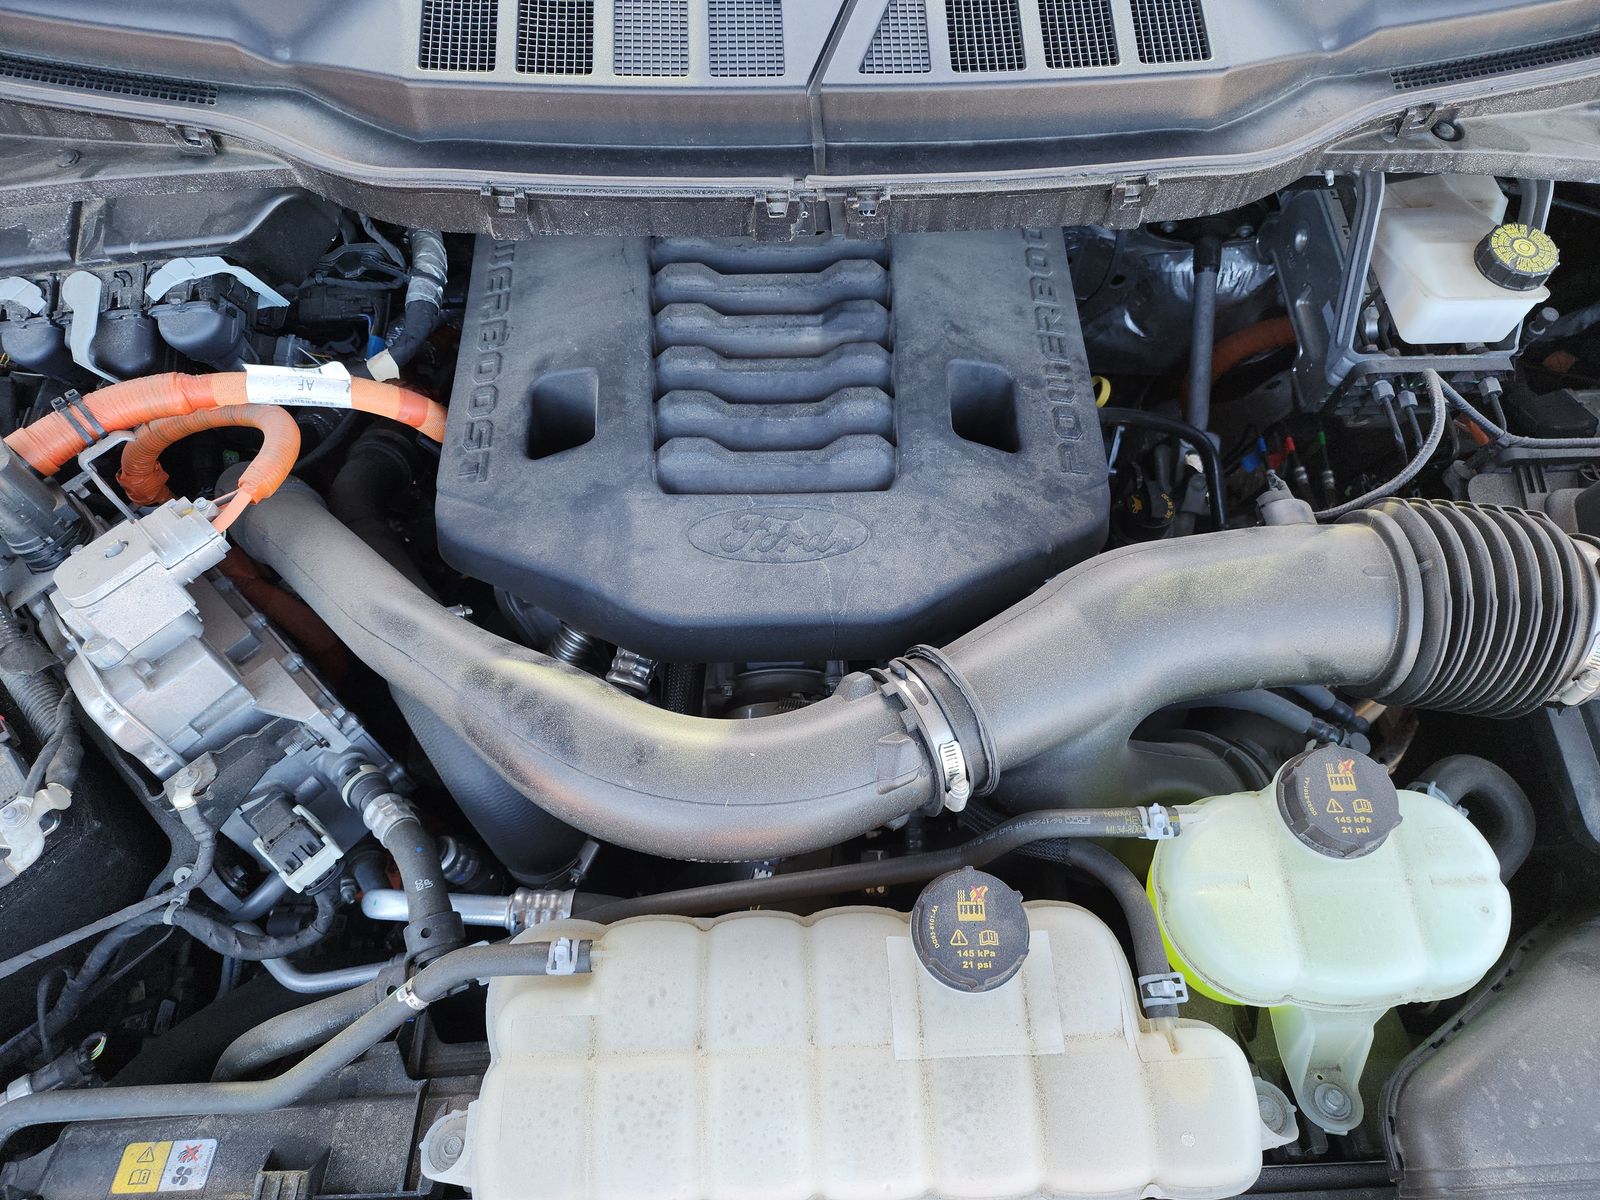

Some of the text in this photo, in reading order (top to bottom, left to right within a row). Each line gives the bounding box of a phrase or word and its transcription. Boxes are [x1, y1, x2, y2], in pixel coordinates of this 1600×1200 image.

[1022, 227, 1089, 475] POWERBOO
[458, 238, 516, 483] WERBOOST
[297, 379, 315, 391] AF
[719, 512, 839, 554] Ford
[1334, 816, 1373, 824] 145 kPa
[1341, 826, 1371, 834] 21 psi
[956, 949, 996, 957] 145 kPa
[962, 961, 992, 970] 21 psi
